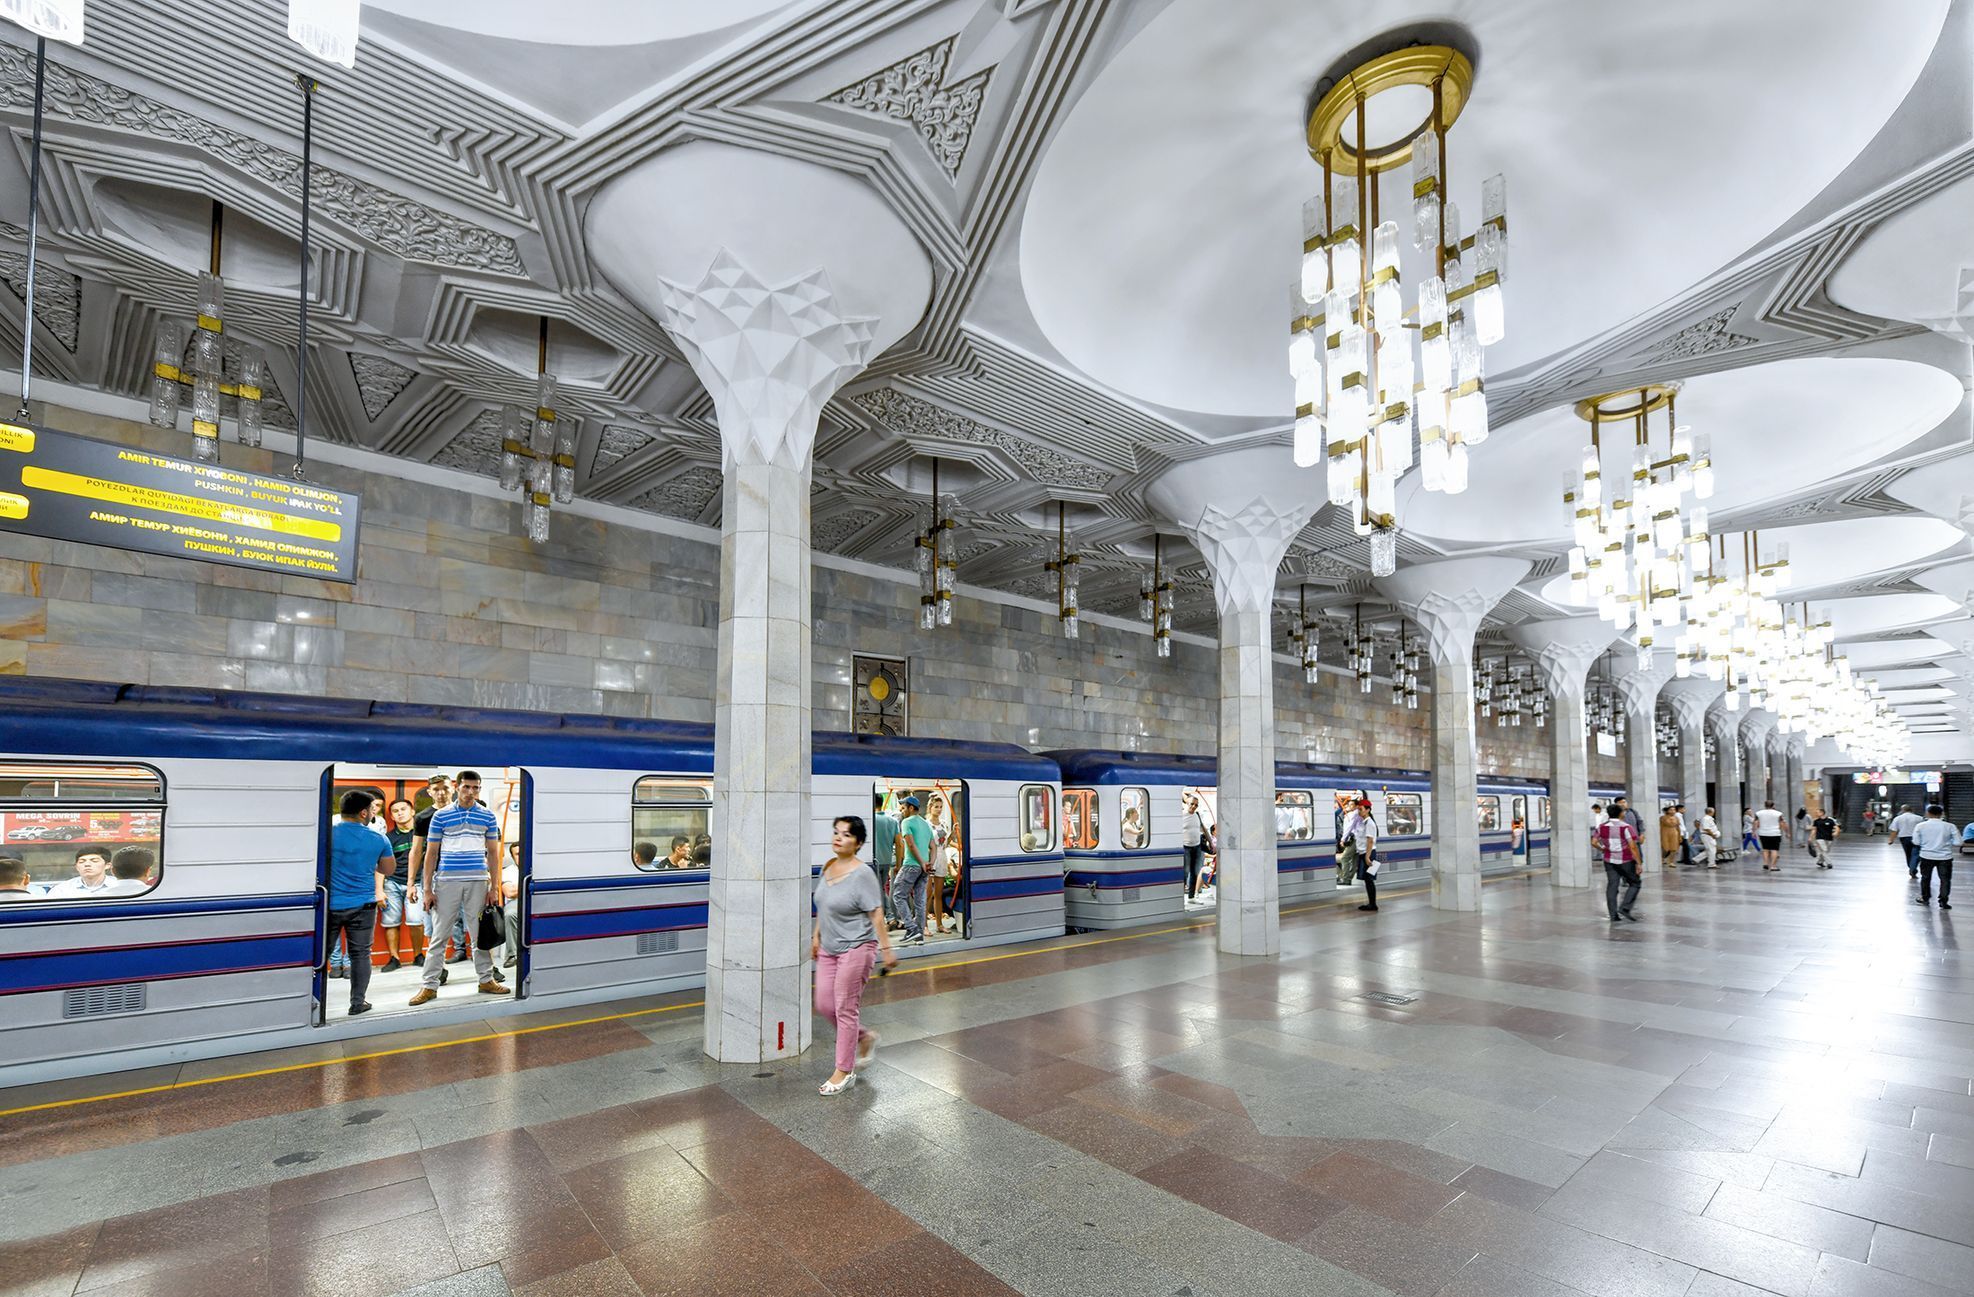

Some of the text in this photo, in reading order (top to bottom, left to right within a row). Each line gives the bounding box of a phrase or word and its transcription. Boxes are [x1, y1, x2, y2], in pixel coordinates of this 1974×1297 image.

[118, 451, 150, 465] AMIR
[151, 458, 192, 474] TEMUR
[254, 479, 291, 493] HAMID
[86, 479, 145, 496] POYEZDLAR
[147, 490, 194, 505] QUYIDAGI
[196, 500, 254, 516] BEKATLARGA
[131, 496, 138, 504] К
[140, 499, 188, 511] ПОЕЗДАМ
[190, 507, 204, 515] ДО
[251, 491, 288, 505] BUYUK
[89, 511, 128, 525] АМИР
[130, 518, 171, 532] ТЕМУР
[235, 535, 276, 551] ХАМИД
[242, 550, 275, 562] БУЮК
[276, 555, 305, 568] ИПАК
